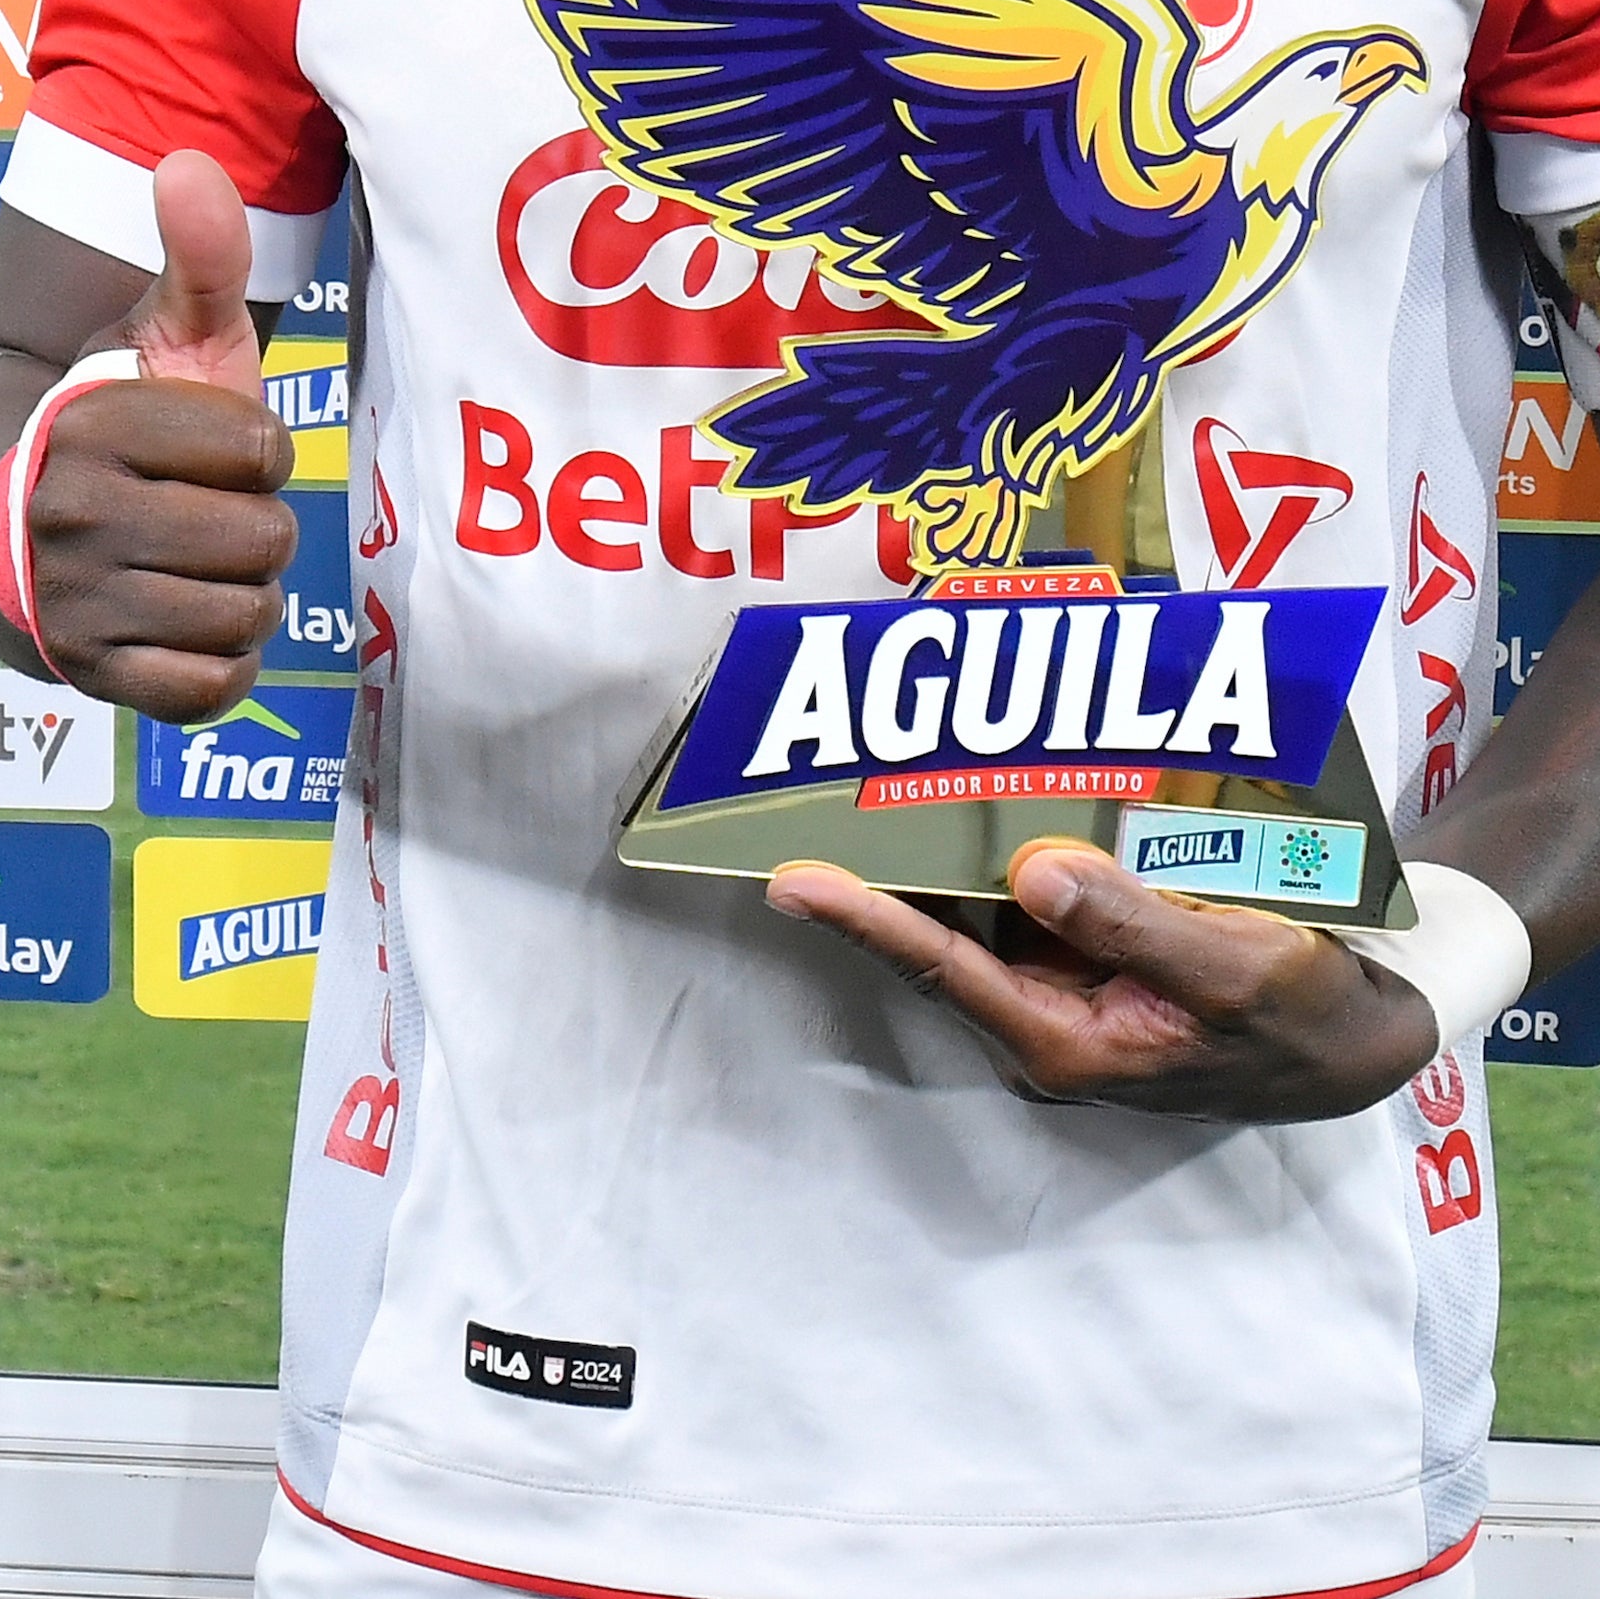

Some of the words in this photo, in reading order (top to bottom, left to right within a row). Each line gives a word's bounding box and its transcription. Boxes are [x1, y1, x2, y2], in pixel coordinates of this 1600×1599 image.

[950, 577, 1110, 597] CERVEZA
[742, 601, 1278, 777] AGUILA
[181, 732, 294, 800] fna
[300, 788, 330, 802] DEL
[879, 776, 981, 802] JUGADOR
[994, 773, 1032, 792] DEL
[1045, 772, 1142, 791] PARTIDO
[1143, 832, 1235, 869] AGUILA
[189, 900, 321, 974] AGUIL
[470, 1341, 531, 1380] FILA
[571, 1360, 622, 1383] 2024
